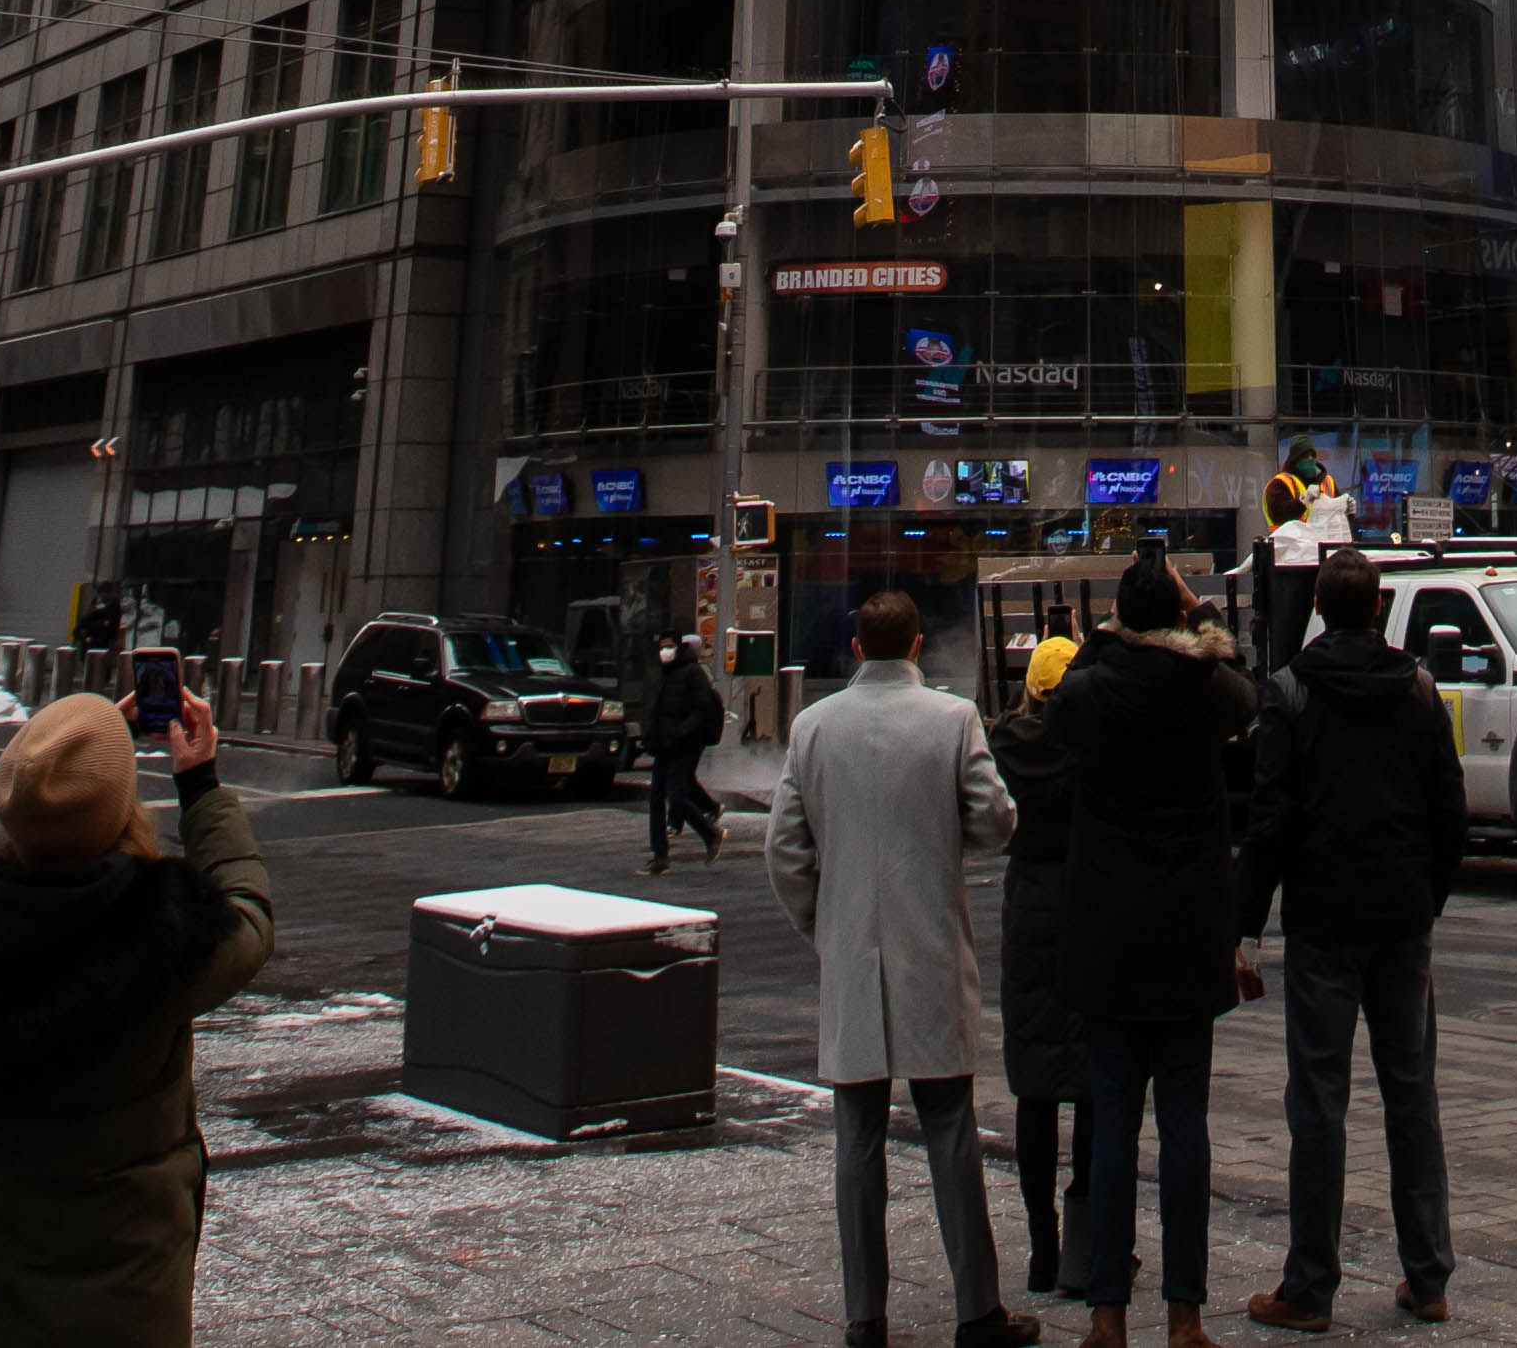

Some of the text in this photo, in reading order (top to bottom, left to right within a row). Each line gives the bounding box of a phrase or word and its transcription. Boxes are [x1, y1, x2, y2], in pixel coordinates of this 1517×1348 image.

[776, 266, 941, 291] BRANDED CITIES
[977, 358, 1079, 390] Nasdaq
[847, 474, 891, 484] CNBC
[1106, 472, 1152, 482] CNBC
